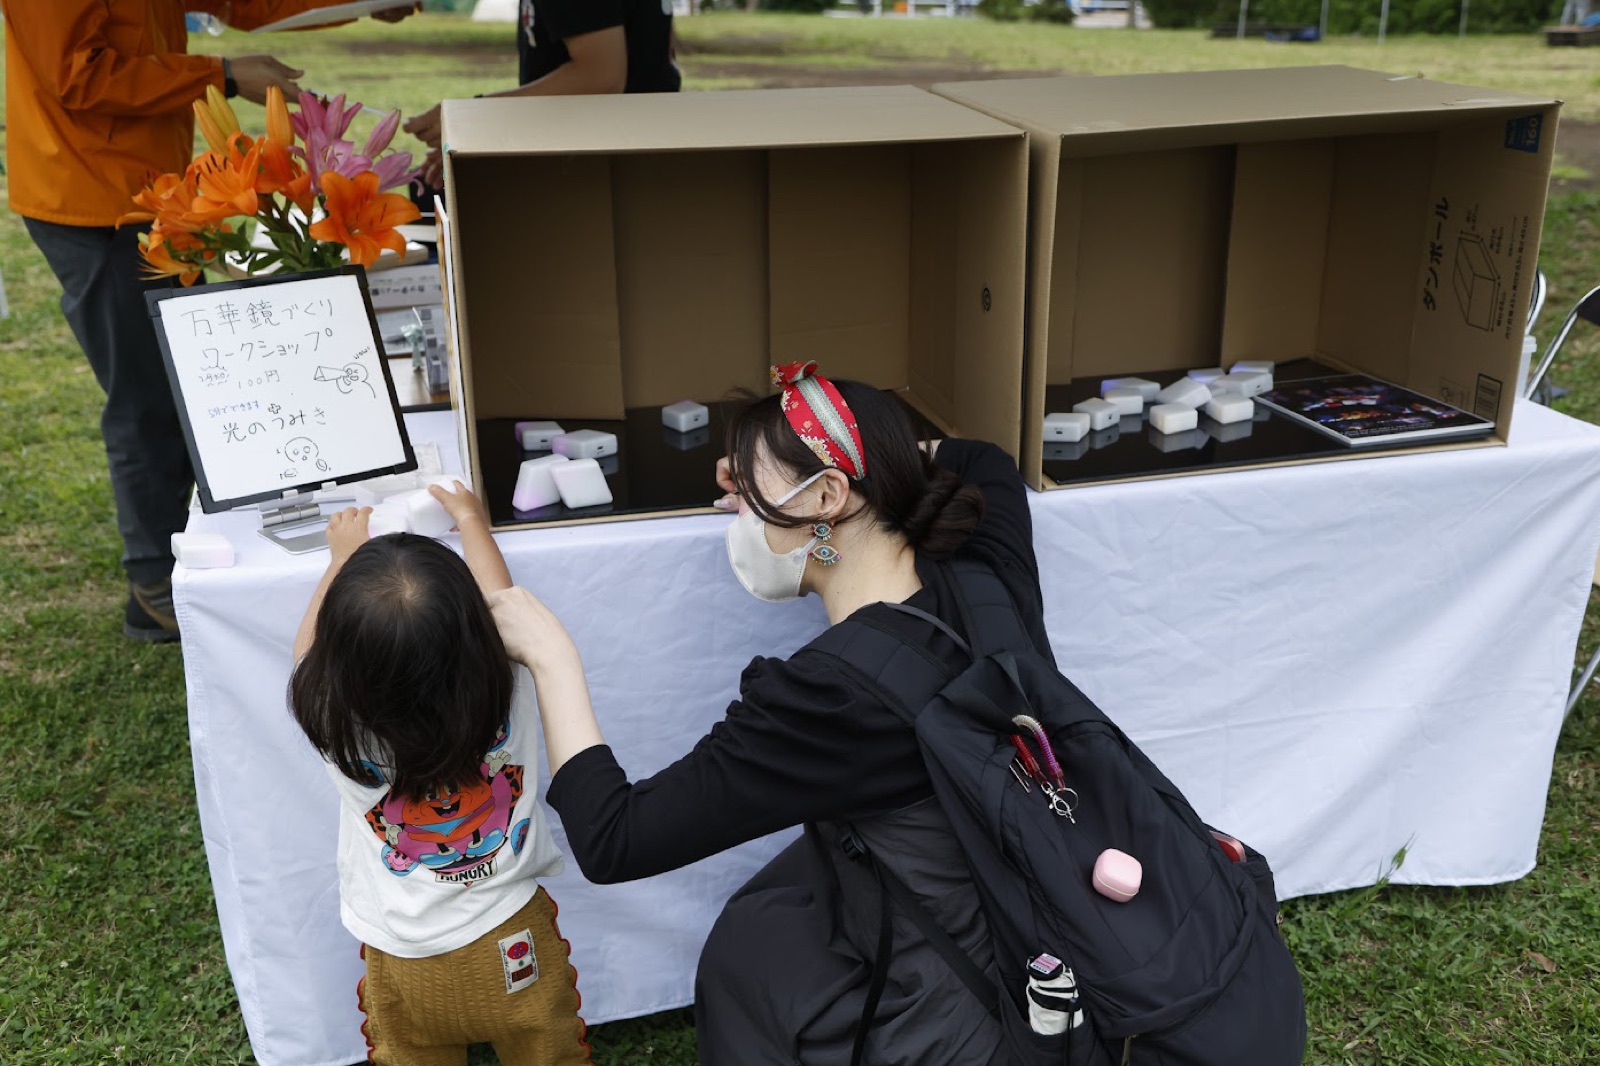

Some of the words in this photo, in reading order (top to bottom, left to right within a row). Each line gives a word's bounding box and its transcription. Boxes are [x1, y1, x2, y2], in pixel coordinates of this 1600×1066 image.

[1422, 197, 1449, 312] ダンボール
[181, 299, 333, 337] 万華鏡づくり
[202, 327, 334, 368] ワークショップ
[237, 369, 281, 389] 100円
[222, 406, 326, 443] 光のつみき
